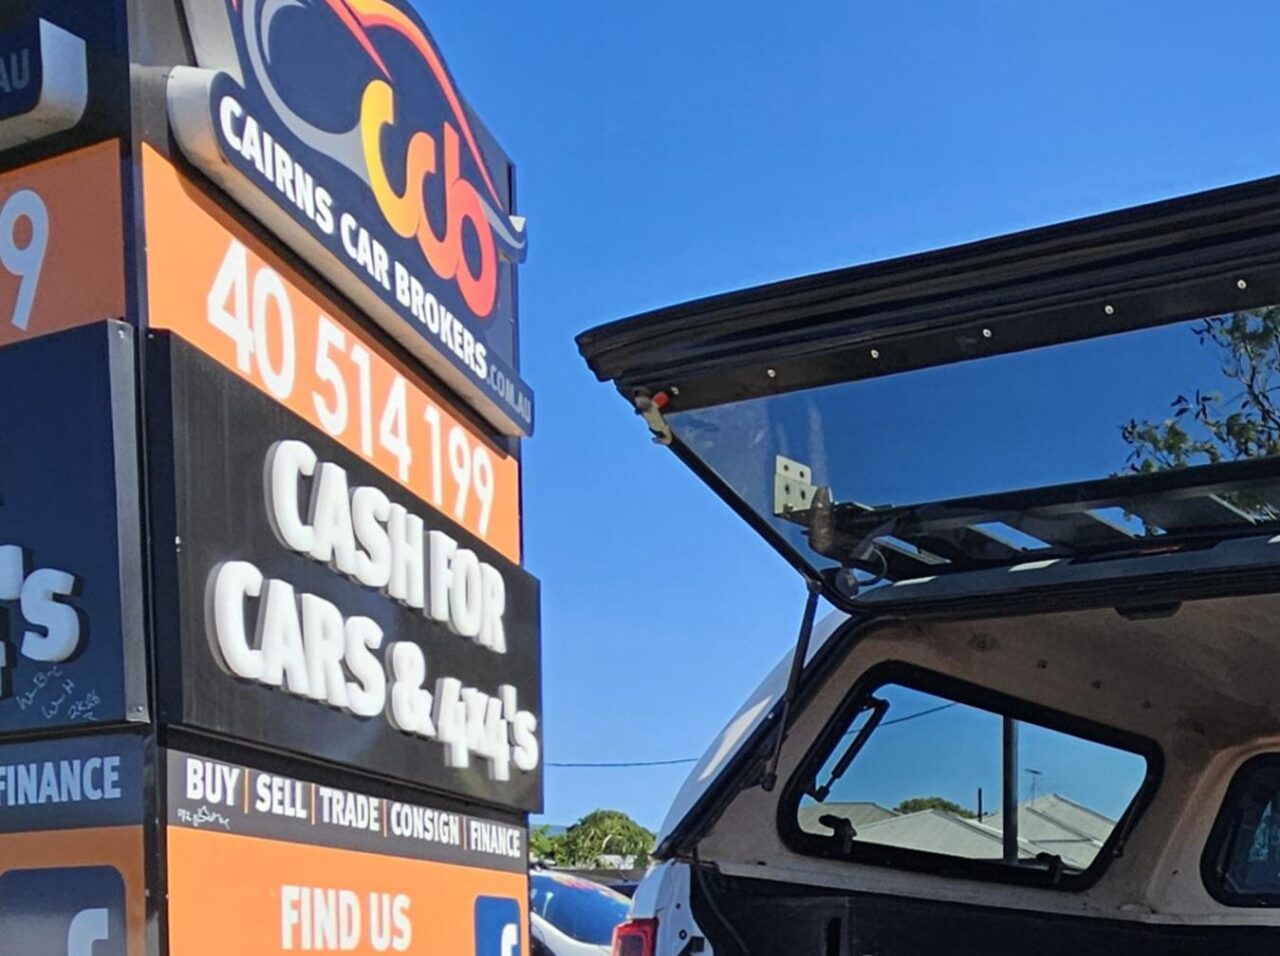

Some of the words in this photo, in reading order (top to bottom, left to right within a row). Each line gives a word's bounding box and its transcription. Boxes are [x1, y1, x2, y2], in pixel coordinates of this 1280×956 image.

[219, 95, 335, 234] CAIRNS
[340, 212, 391, 291] CAR
[207, 238, 296, 400] 40
[312, 314, 412, 484] 514
[424, 402, 495, 542] 199
[264, 439, 425, 609] CASH
[424, 529, 507, 654] FOR
[205, 560, 386, 717] CARS
[385, 641, 436, 737] &
[186, 757, 240, 806] BUY
[255, 773, 307, 819] SELL
[320, 787, 379, 832] TRADE
[390, 800, 460, 846] CONSIGN
[470, 820, 521, 858] FINANCE
[280, 884, 361, 951] FIND
[369, 892, 413, 952] US
